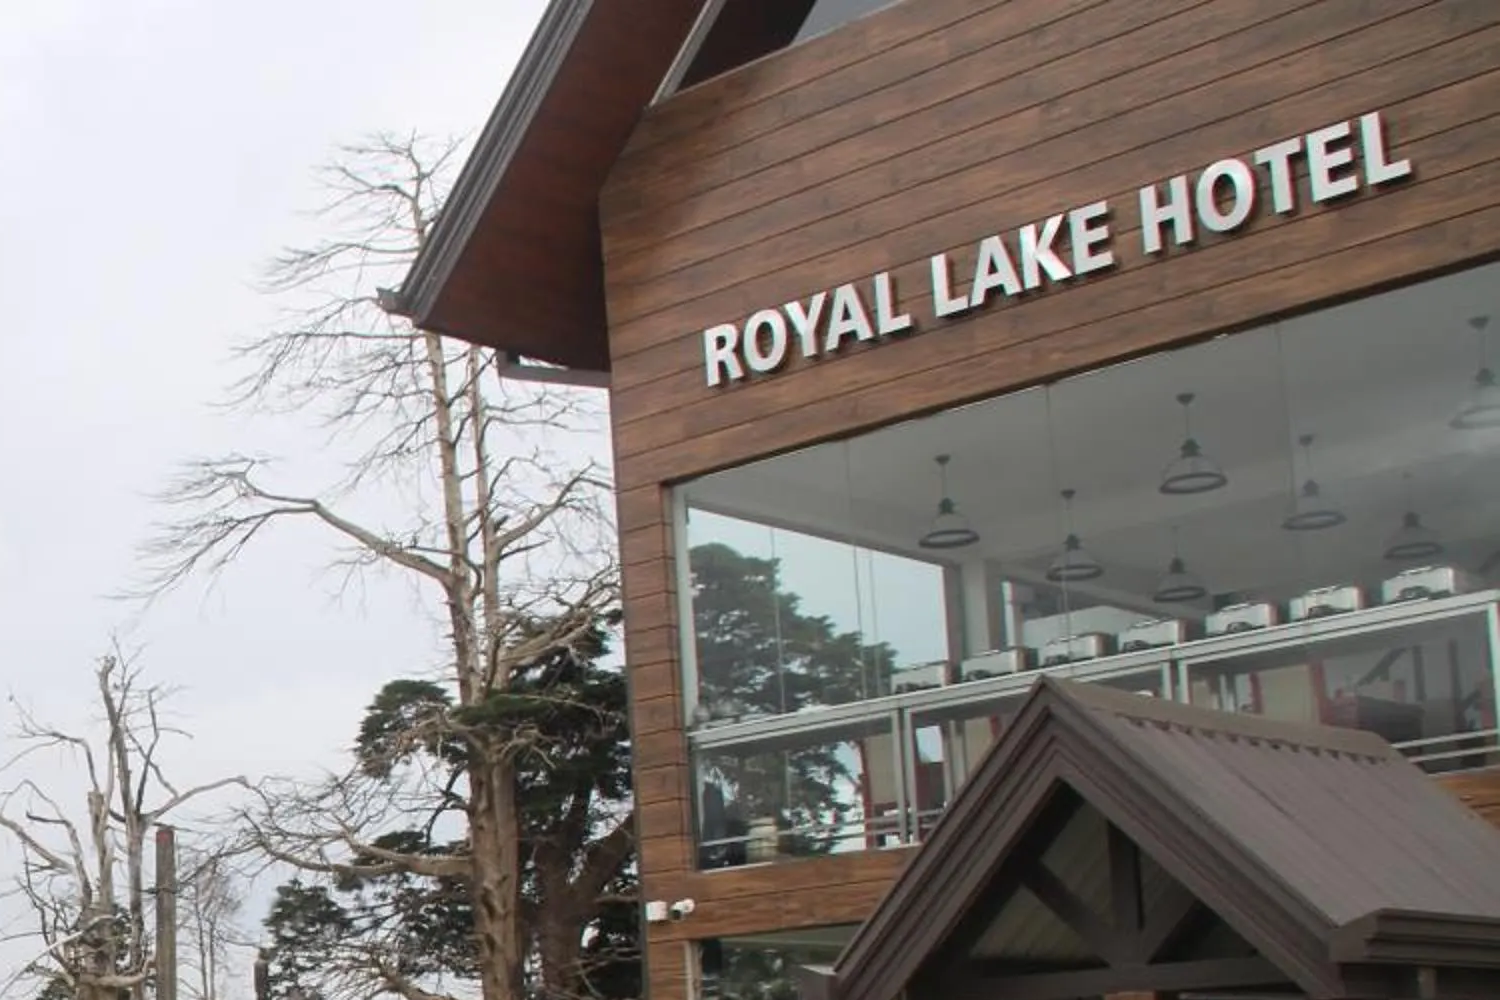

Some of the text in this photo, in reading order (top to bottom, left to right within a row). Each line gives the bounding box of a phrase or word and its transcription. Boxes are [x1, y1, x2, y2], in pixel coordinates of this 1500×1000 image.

[704, 111, 1412, 387] ROYAL LAKE HOTEL
